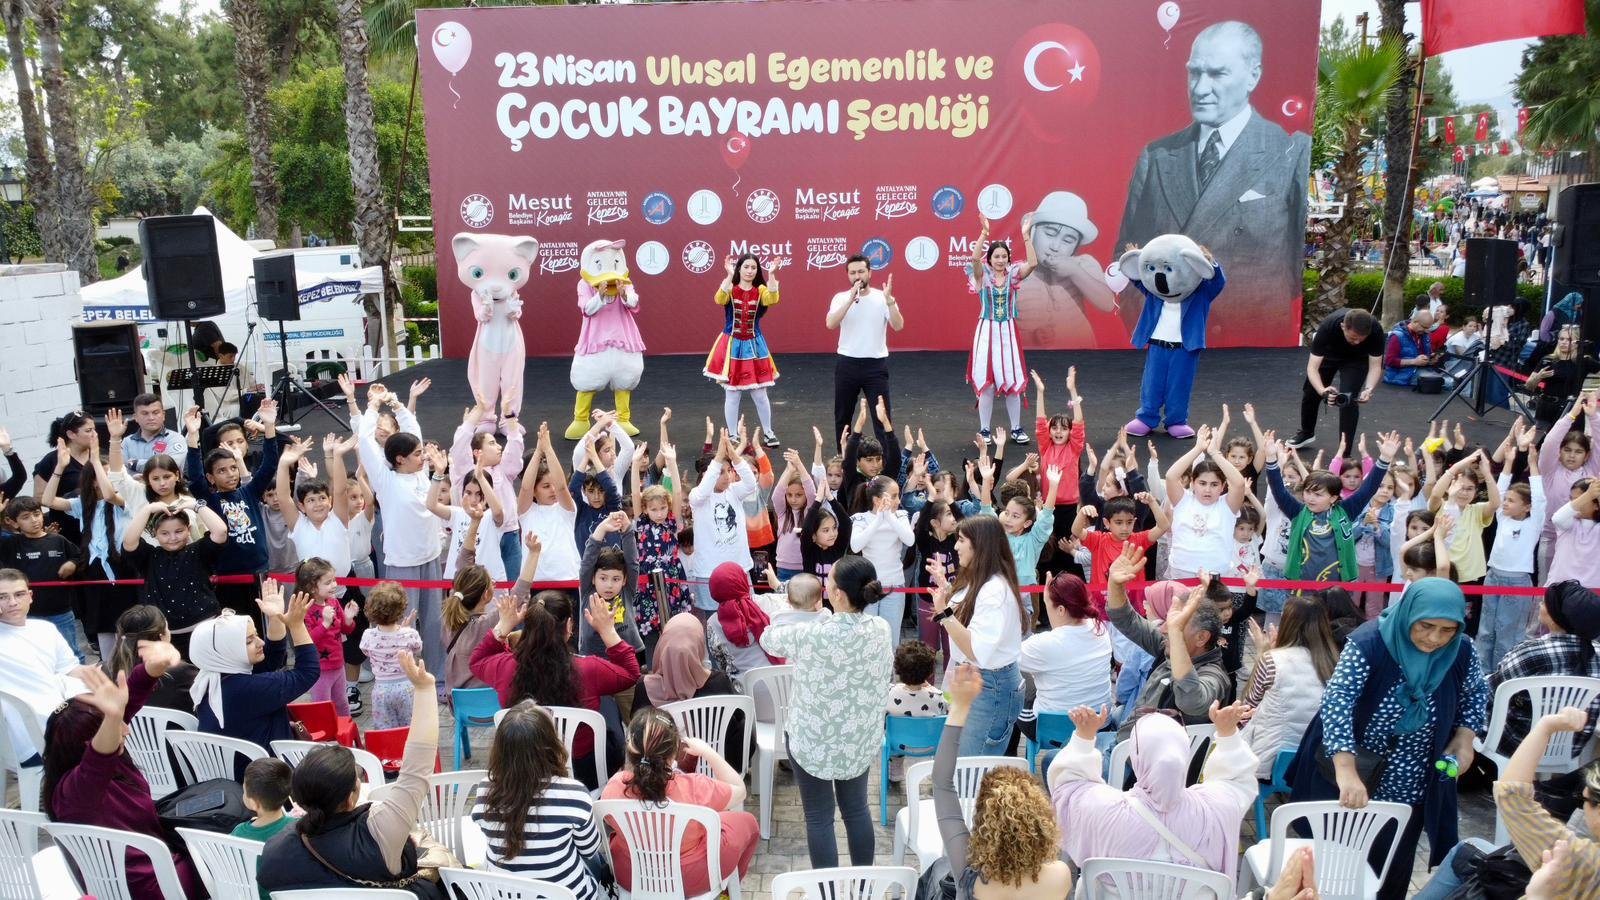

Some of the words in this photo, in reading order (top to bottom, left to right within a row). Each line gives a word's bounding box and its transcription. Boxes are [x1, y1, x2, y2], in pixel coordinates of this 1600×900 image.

[494, 52, 539, 87] 23
[543, 54, 636, 86] Nisan
[646, 53, 756, 86] Ulusal
[768, 48, 946, 90] Egemenlik
[955, 55, 994, 80] ve
[495, 92, 652, 152] ÇOCUK
[658, 96, 840, 137] BAYRAMI
[846, 93, 989, 141] Şenliği
[508, 193, 572, 210] Mesut
[586, 190, 627, 198] ANTALYA'NIN
[795, 188, 861, 205] Mesut
[536, 210, 573, 228] Kocagöz
[823, 205, 861, 222] Kocagöz
[730, 240, 792, 256] Mesut
[948, 236, 1012, 253] Mest
[298, 288, 321, 304] KEPEZ
[83, 309, 112, 321] EPEZ
